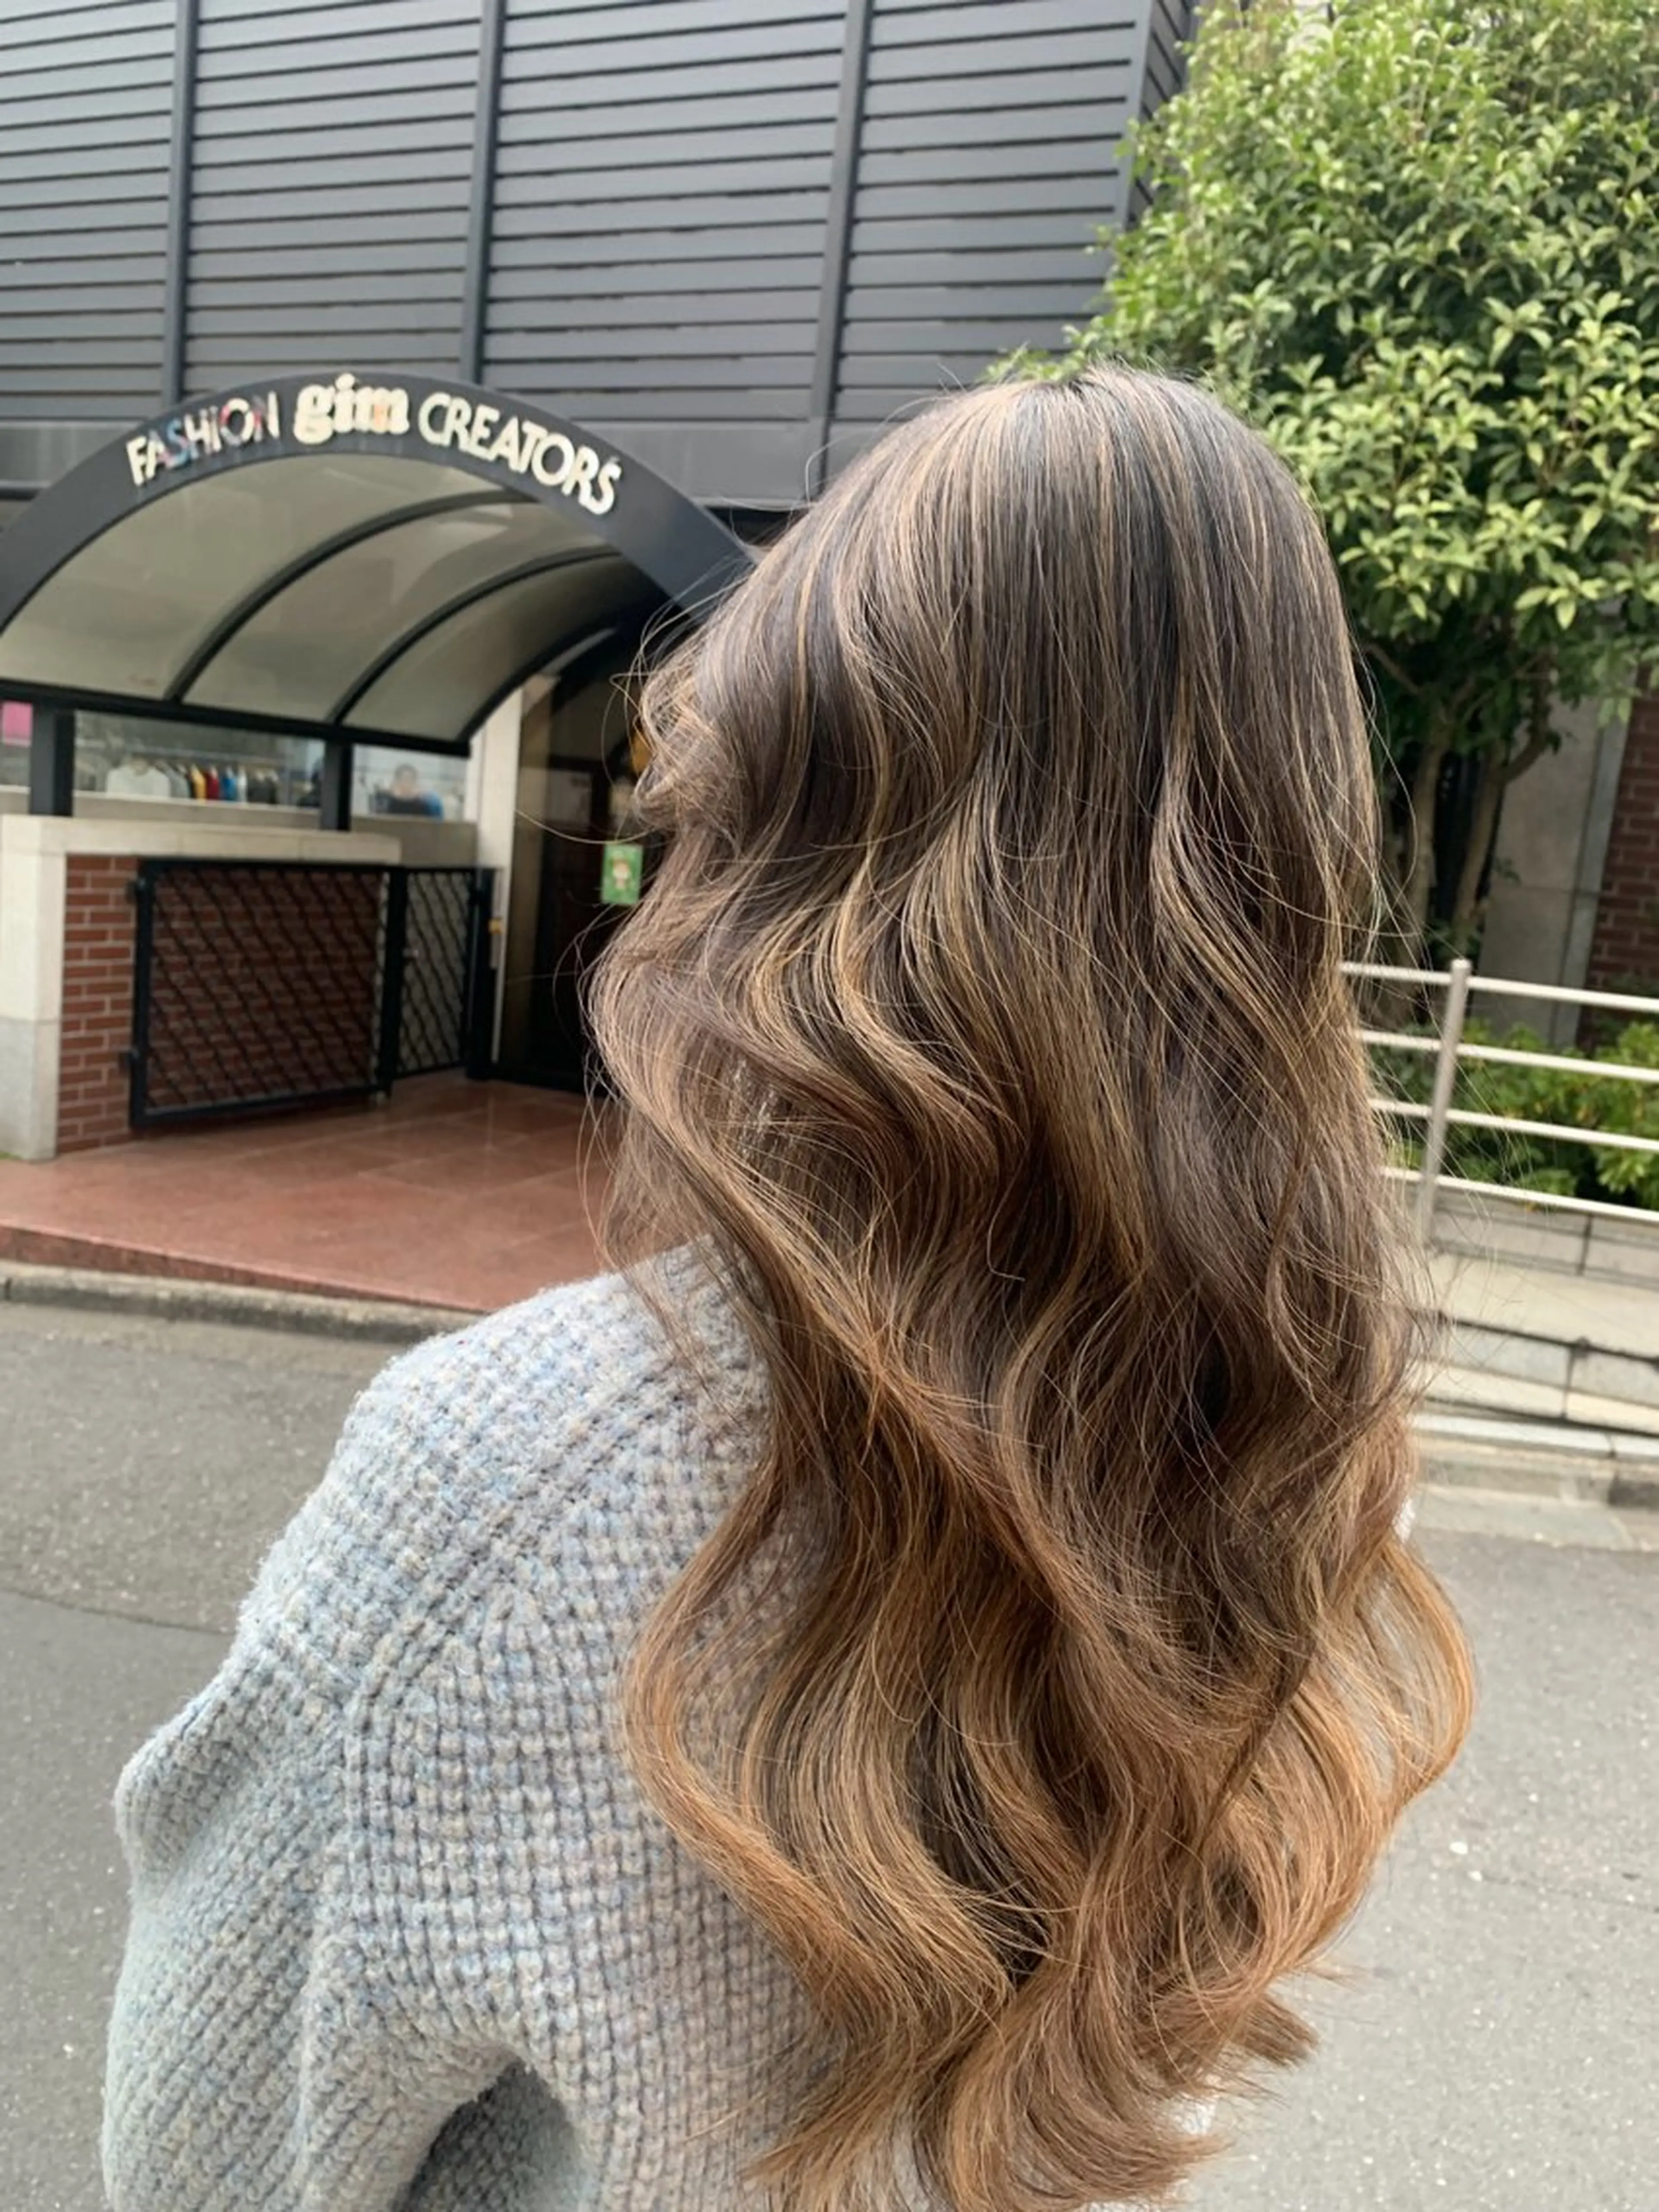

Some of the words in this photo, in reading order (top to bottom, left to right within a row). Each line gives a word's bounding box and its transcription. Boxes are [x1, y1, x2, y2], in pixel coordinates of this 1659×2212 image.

[126, 391, 280, 486] FASHION
[293, 373, 410, 445] gim
[418, 392, 622, 515] CREATORS
